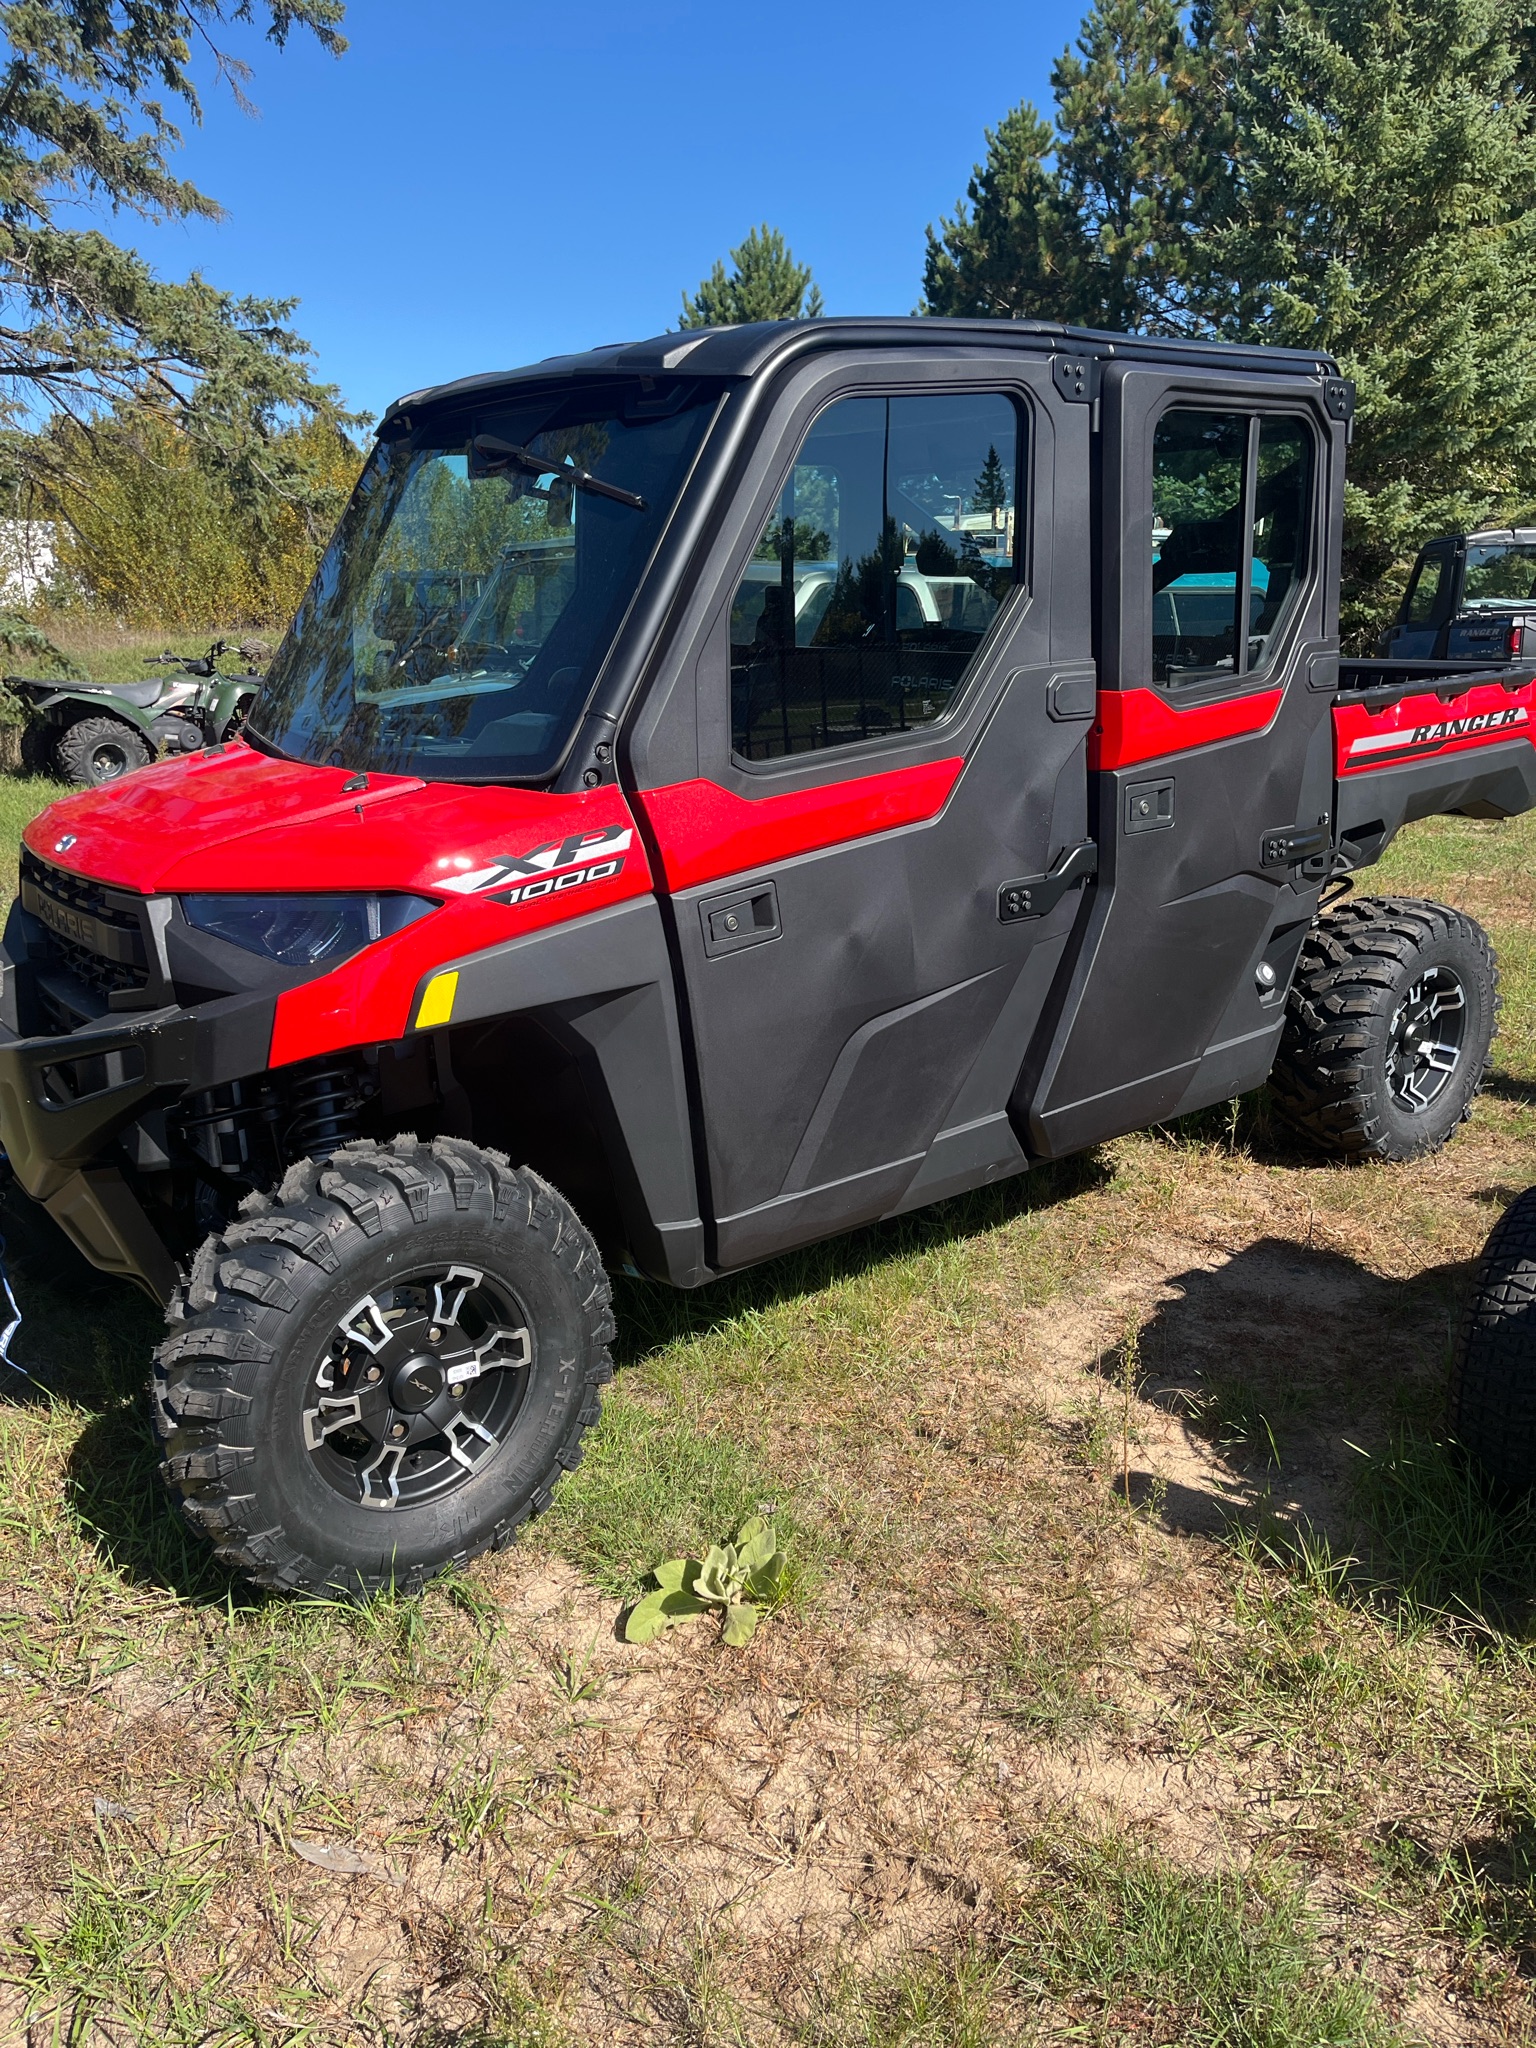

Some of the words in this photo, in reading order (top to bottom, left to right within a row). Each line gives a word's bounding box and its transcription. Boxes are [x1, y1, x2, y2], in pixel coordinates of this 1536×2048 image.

[1460, 629, 1500, 637] RANGER
[891, 676, 953, 691] POLARIS
[1410, 707, 1519, 744] RANGER
[472, 824, 626, 892] XP
[509, 860, 617, 905] 1000
[37, 893, 94, 943] POLARIS
[501, 1355, 576, 1496] X-TERRAIN
